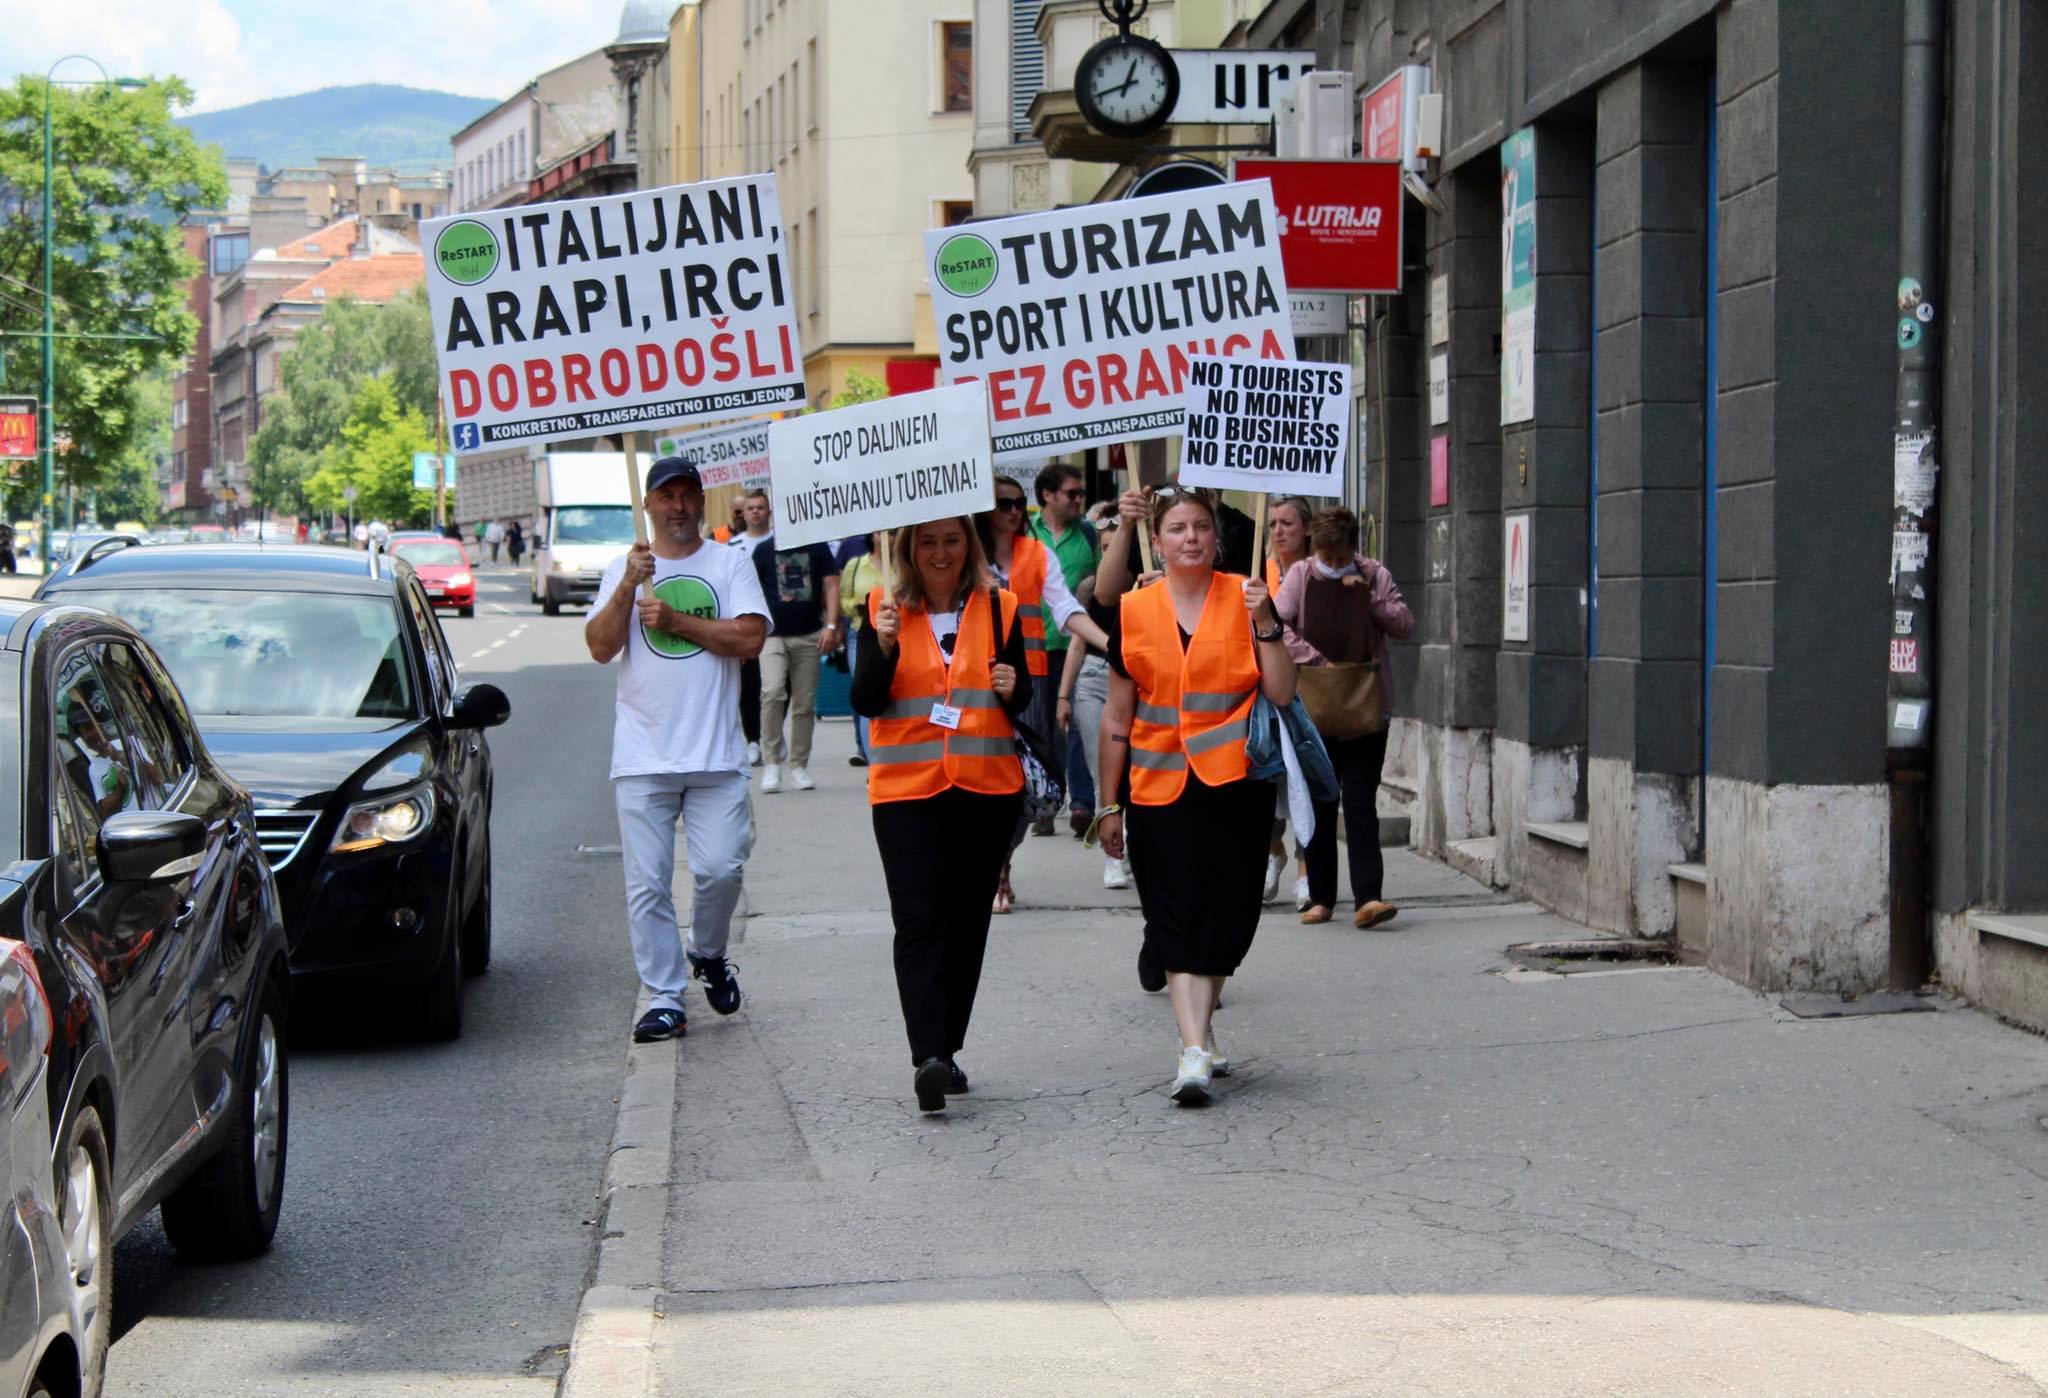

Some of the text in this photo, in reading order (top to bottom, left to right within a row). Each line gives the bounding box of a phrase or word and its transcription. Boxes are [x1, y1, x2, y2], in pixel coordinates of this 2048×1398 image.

[504, 184, 779, 272] ITALIJANI,
[1001, 198, 1266, 286] TURIZAM
[1293, 205, 1382, 227] LUTRIJA
[441, 244, 493, 262] ReSTART
[941, 256, 993, 275] ReSTART
[660, 253, 784, 322] IRCI
[945, 265, 1281, 363] SPORT I KULTURA
[449, 315, 794, 418] DOBRODOŠLI
[953, 364, 1051, 422] EZ
[1191, 361, 1343, 396] NO TOURISTS
[491, 386, 796, 440] KONKRETNO, TRANSPARENTNO I DOSLJEDNO
[994, 410, 1185, 451] KONKRETNO, TRANSPARENT
[1187, 414, 1339, 448] NO BUSINESS
[1207, 389, 1325, 420] NO MONEY
[813, 429, 852, 465] STOP
[857, 412, 938, 456] DALJNJEM
[1187, 440, 1337, 474] NO ECONOMY
[785, 458, 978, 525] UNIŠTAVANJU TURIZMA!
